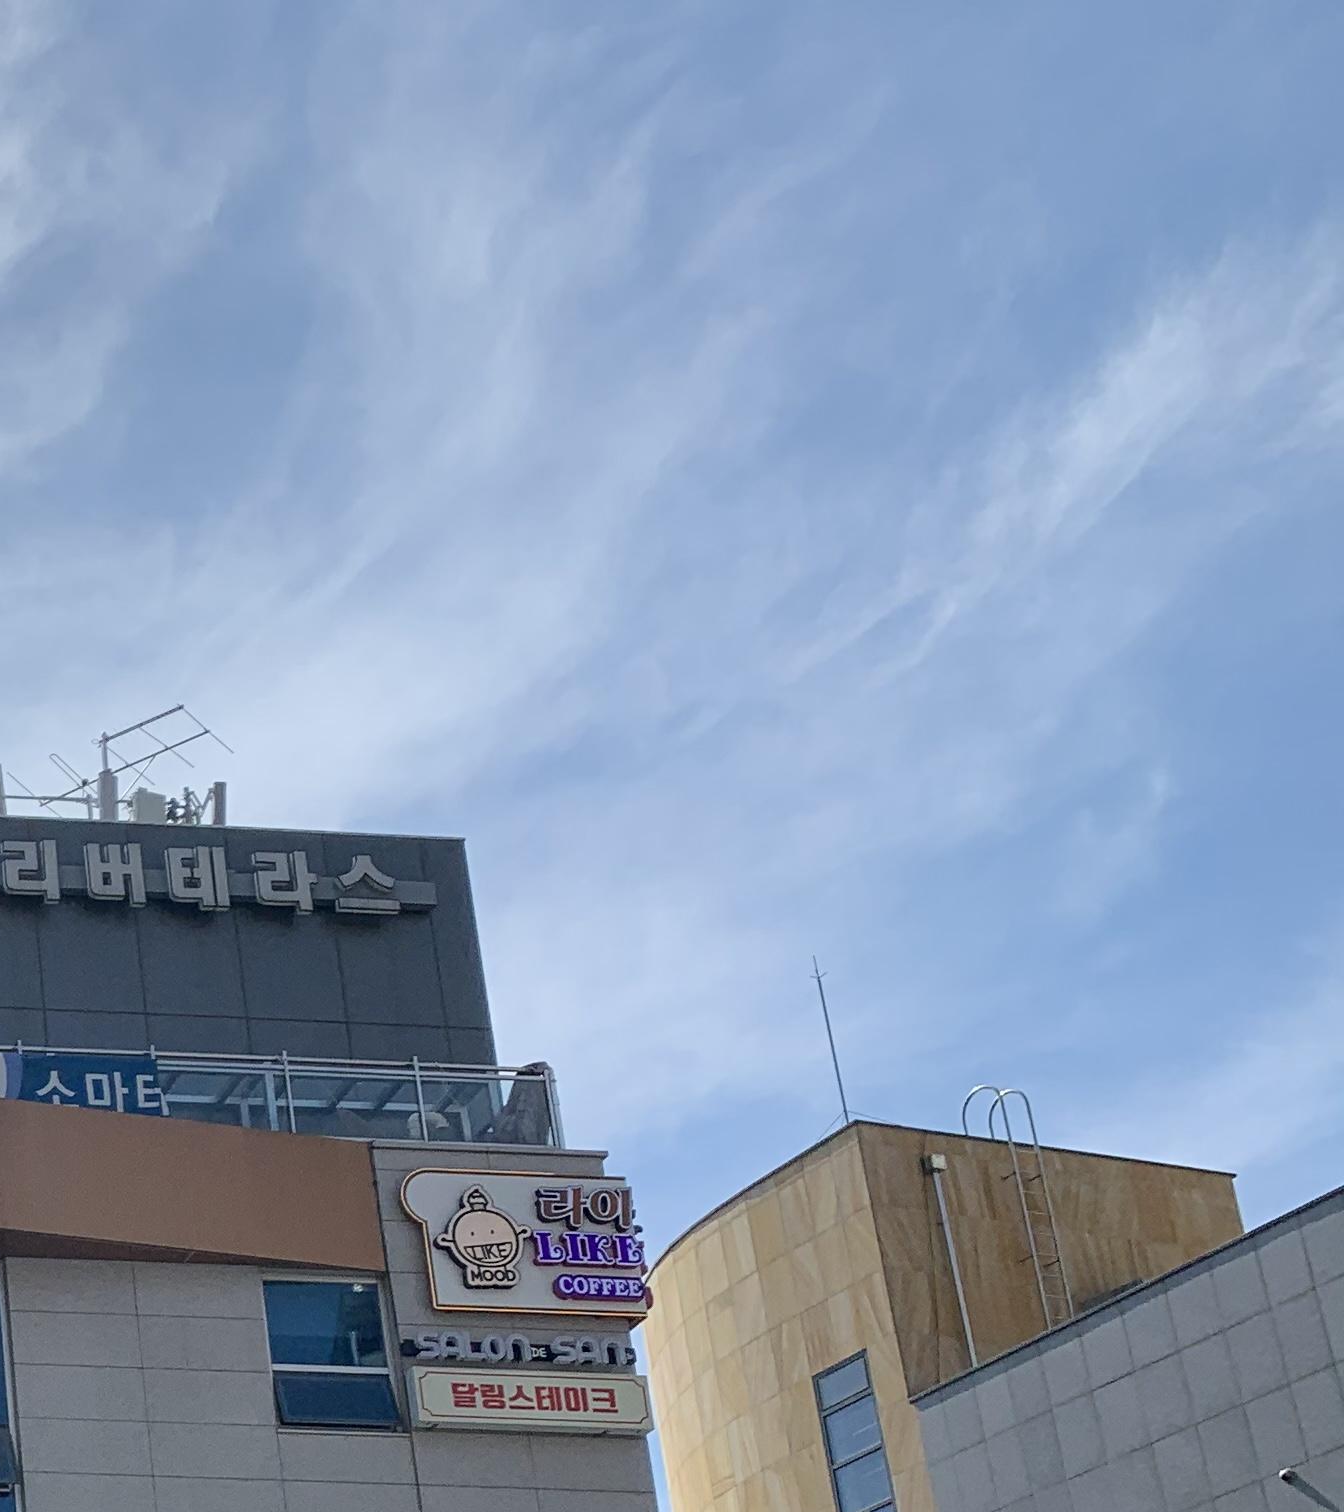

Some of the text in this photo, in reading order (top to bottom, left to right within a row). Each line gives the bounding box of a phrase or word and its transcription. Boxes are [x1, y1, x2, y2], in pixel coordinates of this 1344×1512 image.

[1, 838, 400, 915] 리버테라스
[532, 1231, 646, 1267] LIKE
[470, 1269, 516, 1283] MOOD
[558, 1276, 644, 1298] COFFEE
[450, 1382, 619, 1414] 달링스테이크
